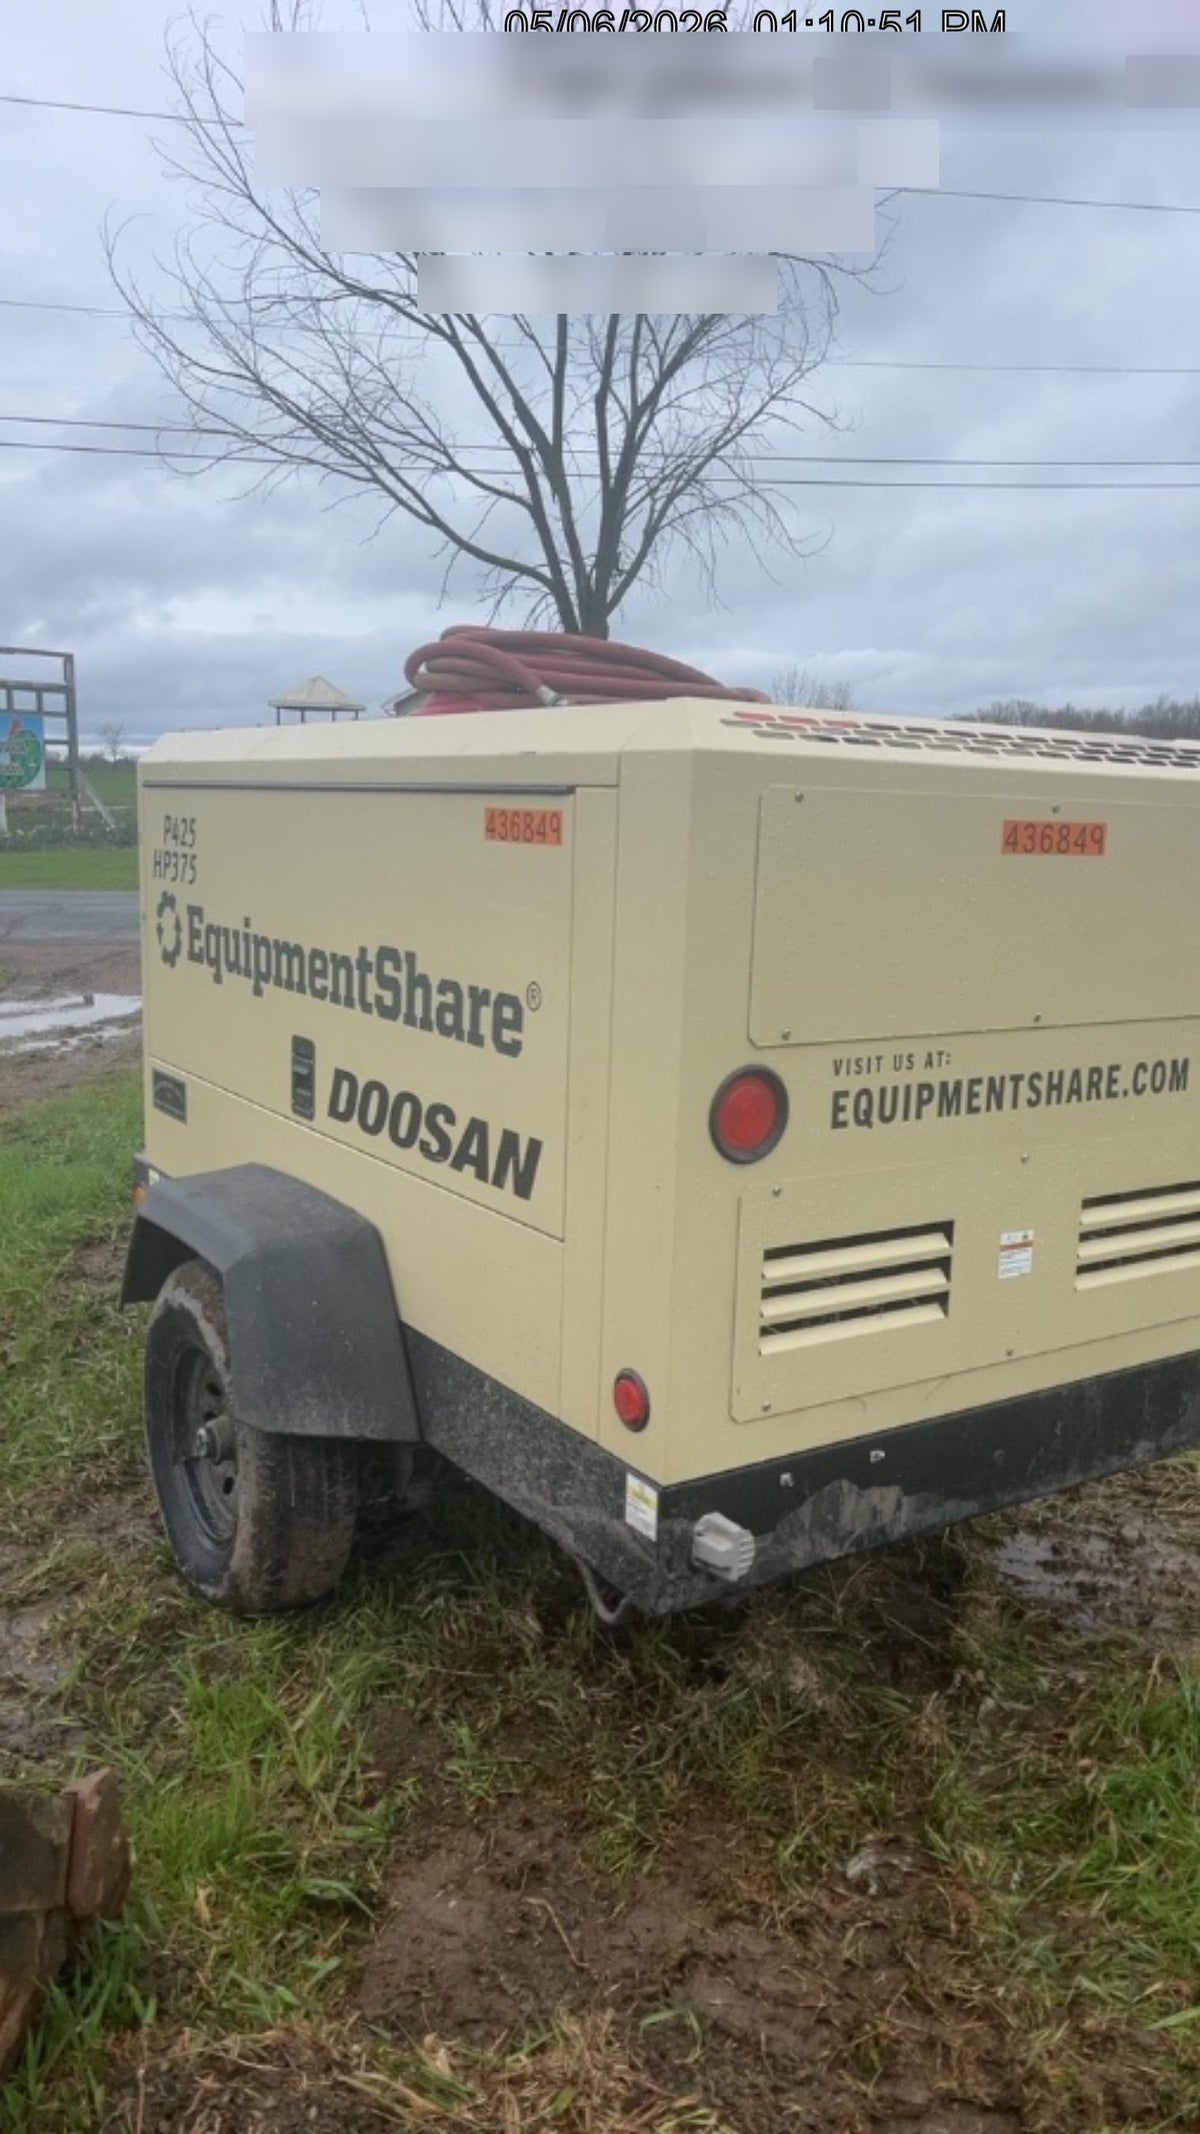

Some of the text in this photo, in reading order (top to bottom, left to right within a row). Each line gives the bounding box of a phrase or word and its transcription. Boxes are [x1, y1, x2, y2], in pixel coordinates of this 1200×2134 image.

[163, 815, 196, 848] P425
[486, 810, 561, 844] 436849
[1004, 823, 1104, 854] 436849
[153, 849, 197, 885] HP375
[833, 1051, 952, 1077] VISIT US AT:
[830, 1057, 1190, 1130] EQUIPMENTSHARE.COM
[327, 1067, 543, 1201] DOOSAN
